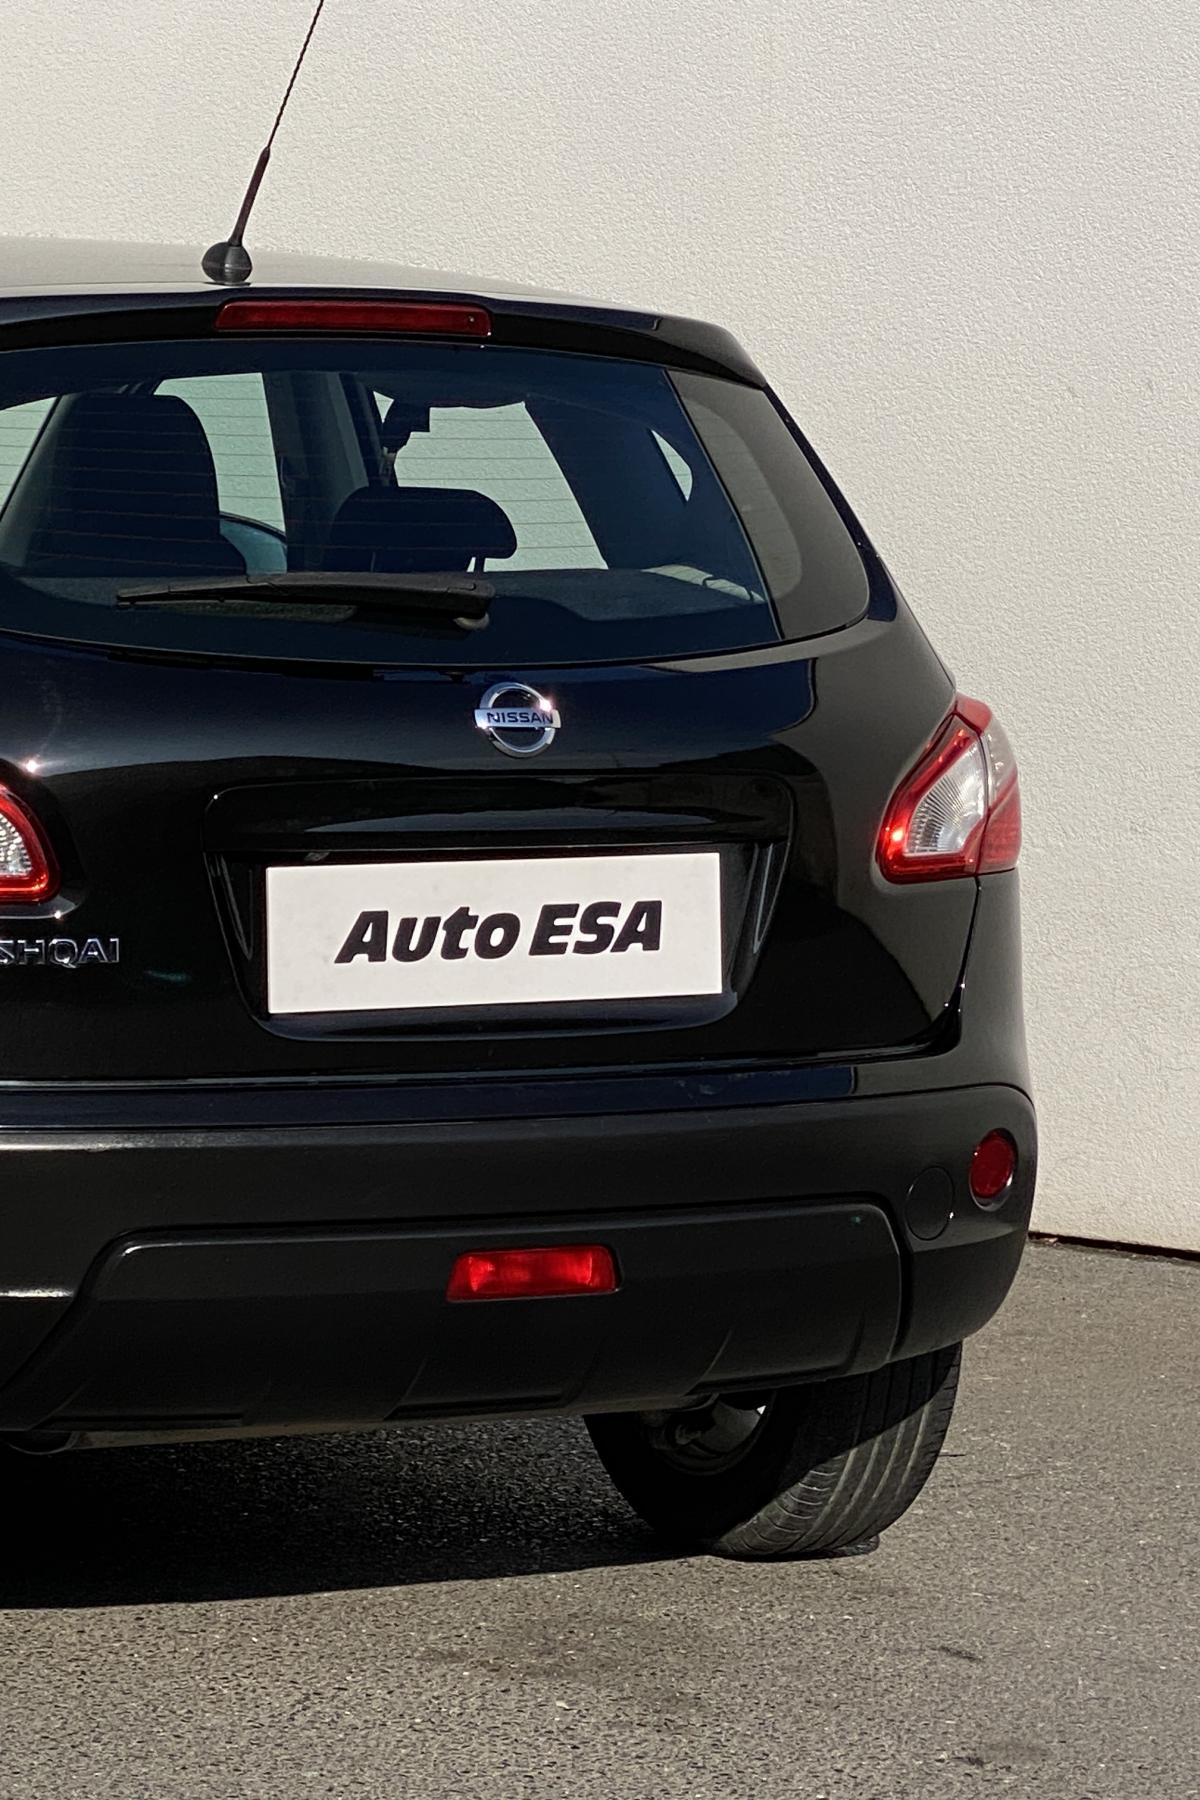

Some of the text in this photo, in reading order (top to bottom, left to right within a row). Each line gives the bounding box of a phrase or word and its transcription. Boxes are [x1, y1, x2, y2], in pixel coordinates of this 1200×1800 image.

[486, 712, 554, 724] NISSAN
[334, 900, 662, 963] Auto ESA
